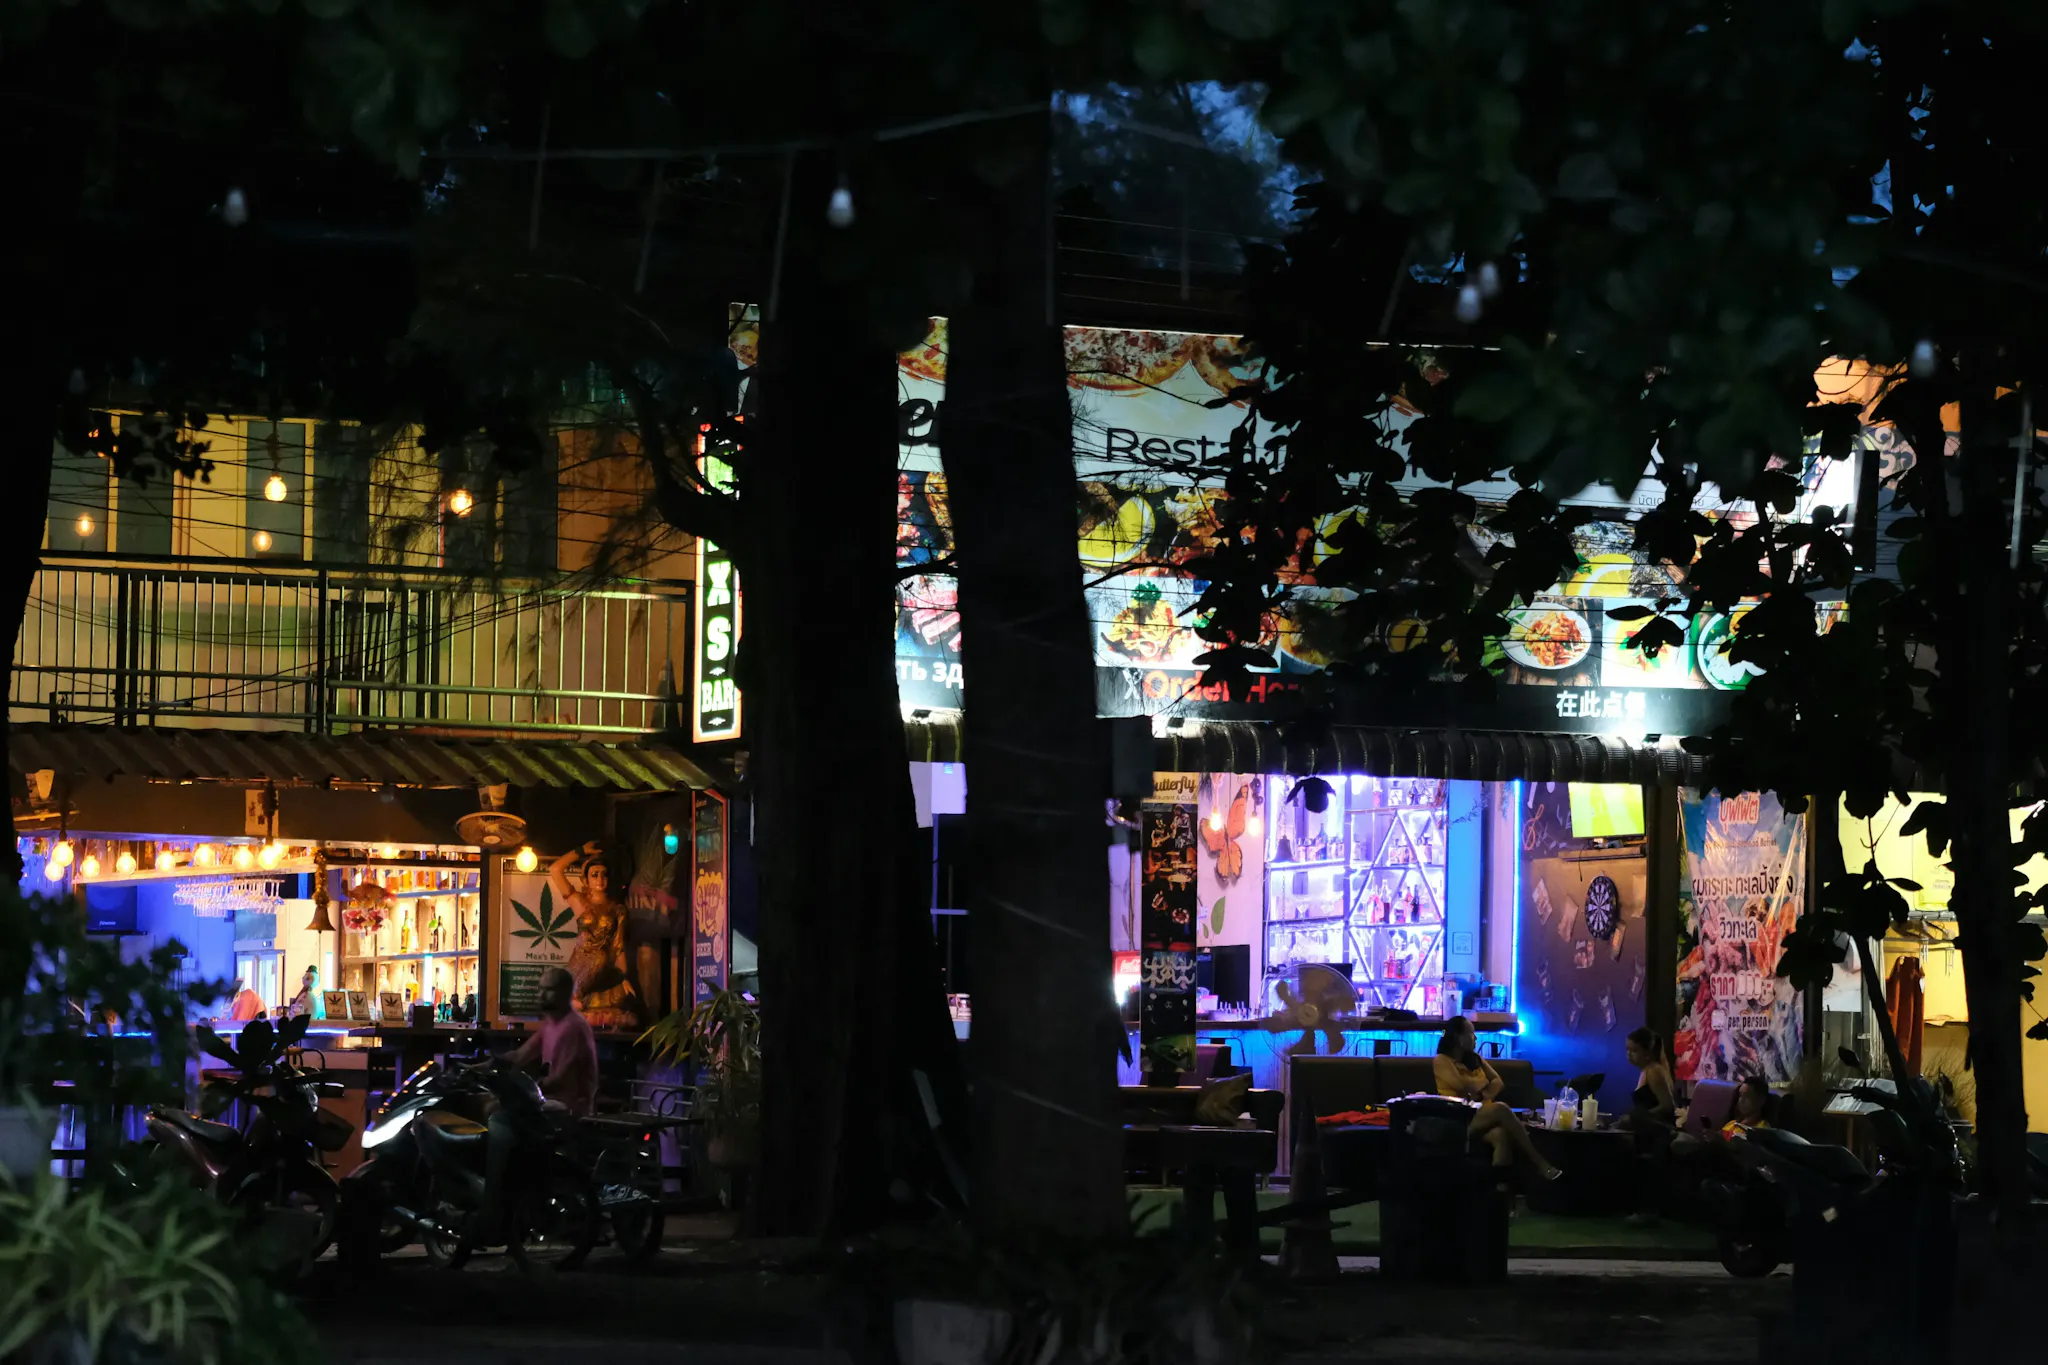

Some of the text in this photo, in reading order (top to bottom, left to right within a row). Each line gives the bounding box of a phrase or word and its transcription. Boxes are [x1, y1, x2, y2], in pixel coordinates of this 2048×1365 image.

[701, 678, 735, 713] BAR
[1155, 775, 1197, 794] utterfly
[525, 951, 564, 961] Max's Bar
[1727, 1016, 1768, 1031] per person
